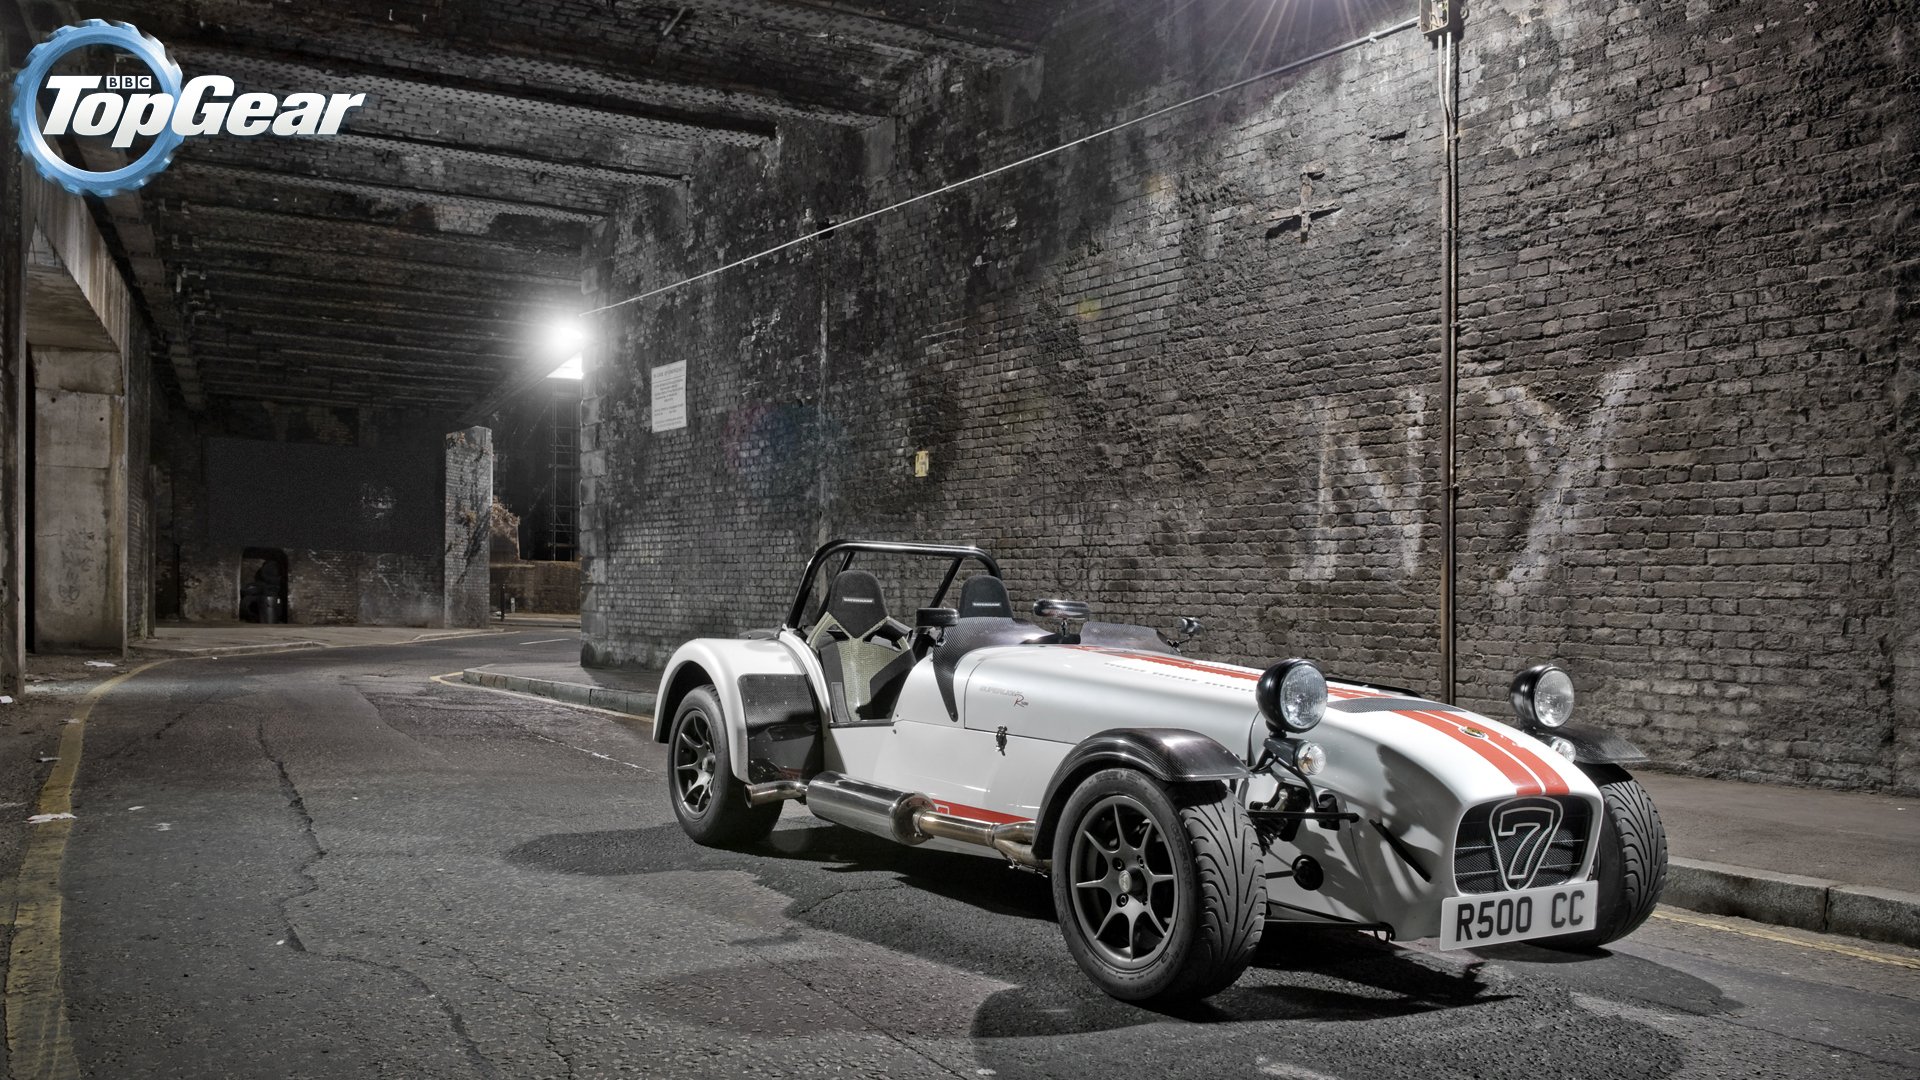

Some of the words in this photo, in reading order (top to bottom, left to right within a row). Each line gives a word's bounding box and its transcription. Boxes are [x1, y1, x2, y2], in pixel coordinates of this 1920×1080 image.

[1498, 806, 1554, 879] 7
[1455, 896, 1533, 942] R500
[1551, 889, 1585, 929] CC
